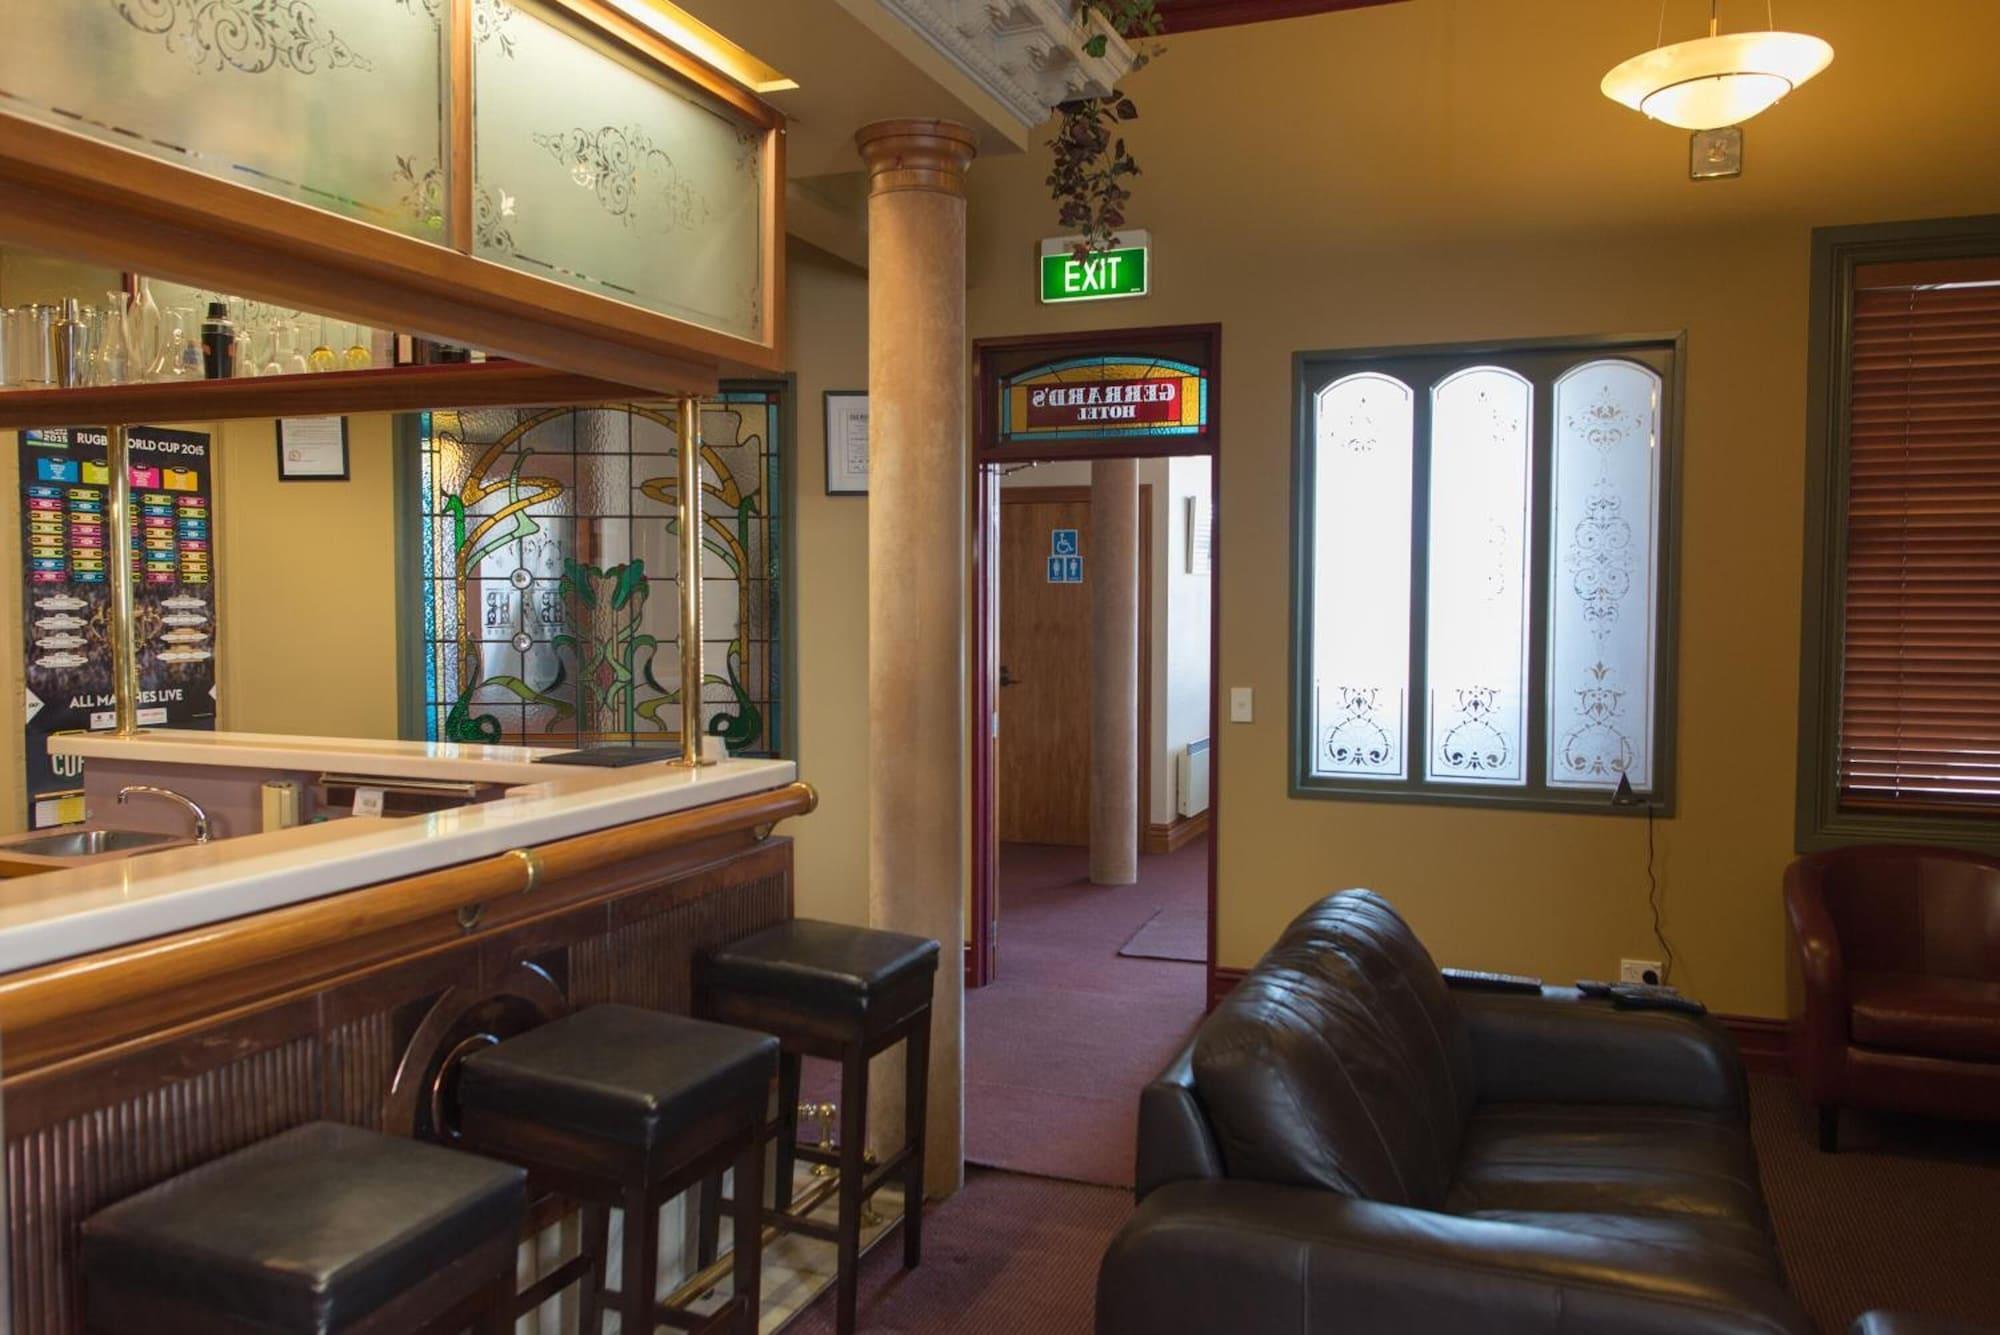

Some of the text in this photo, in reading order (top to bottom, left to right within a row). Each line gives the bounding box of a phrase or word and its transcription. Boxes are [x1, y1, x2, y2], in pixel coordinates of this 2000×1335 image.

[1064, 257, 1122, 292] EXIT
[77, 432, 205, 456] RUGB ORLD CUP 2015
[69, 688, 184, 709] ALL MAHES LIVE
